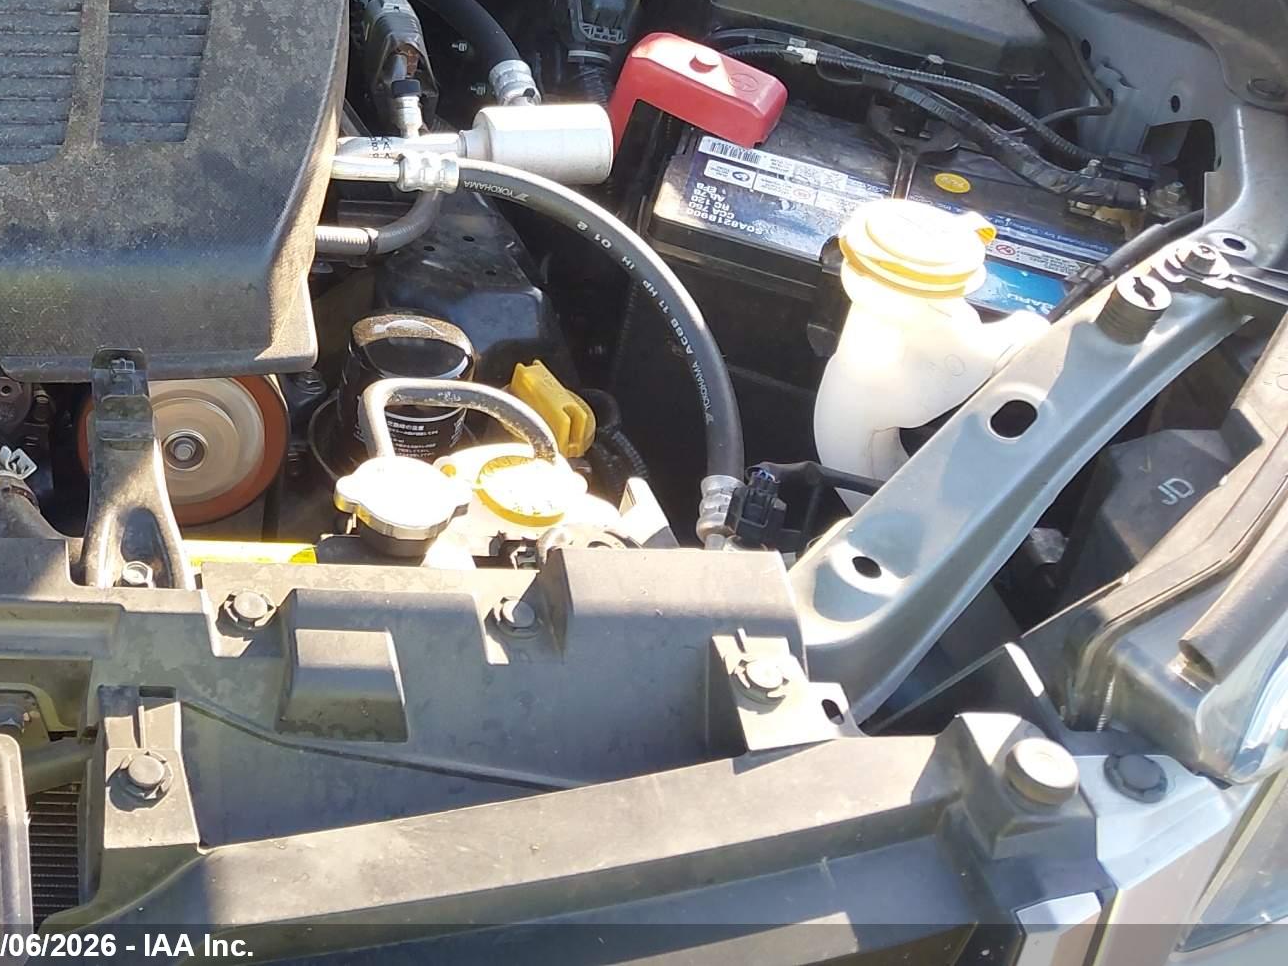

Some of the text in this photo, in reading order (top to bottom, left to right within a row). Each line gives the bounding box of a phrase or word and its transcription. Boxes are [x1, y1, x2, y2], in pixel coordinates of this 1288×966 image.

[463, 180, 513, 199] YOKOHAMA
[712, 207, 735, 220] CCA
[642, 279, 658, 298] HP
[691, 361, 712, 411] YOKOHAMA
[1157, 477, 1194, 505] JD
